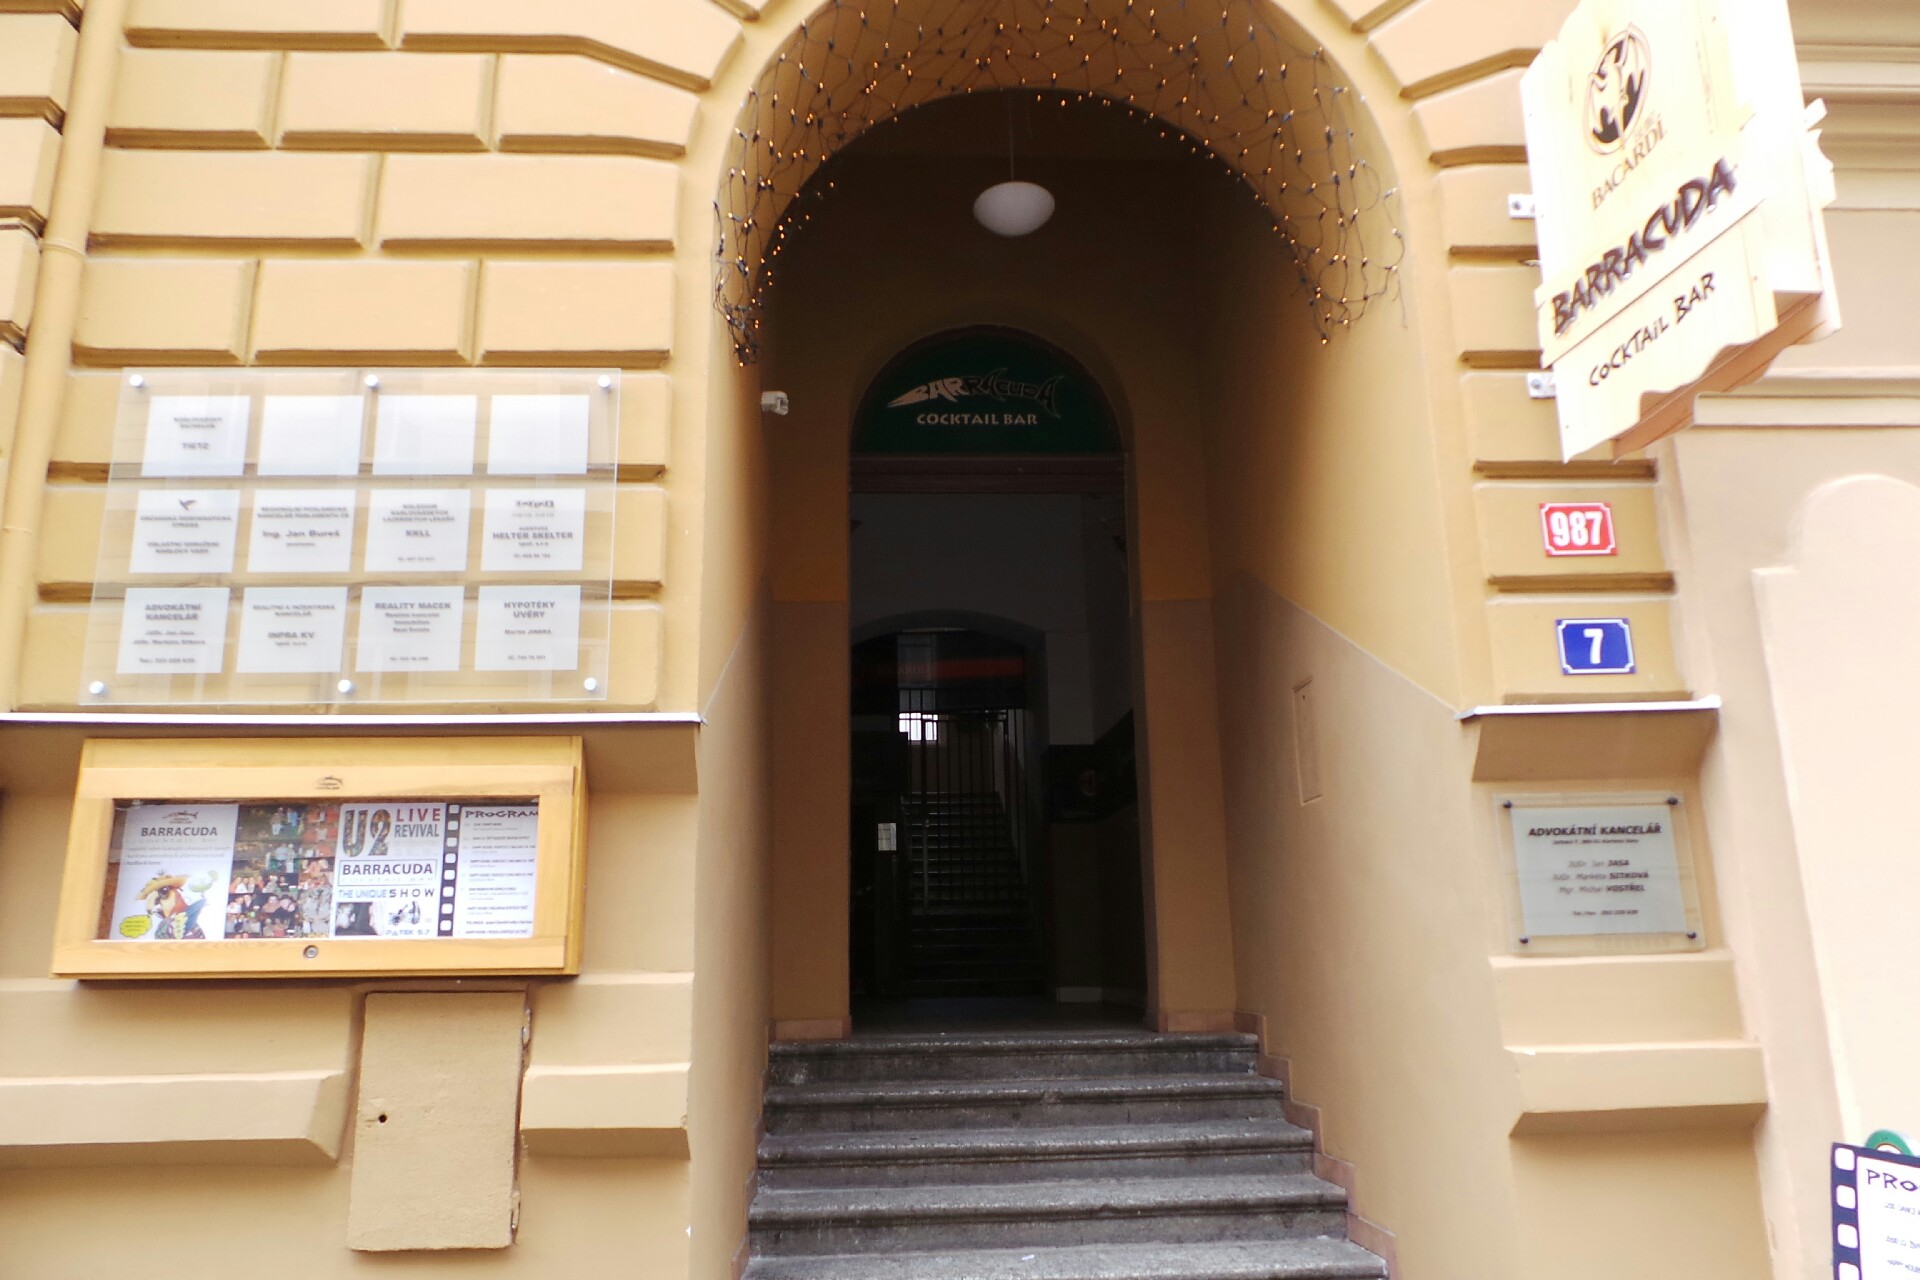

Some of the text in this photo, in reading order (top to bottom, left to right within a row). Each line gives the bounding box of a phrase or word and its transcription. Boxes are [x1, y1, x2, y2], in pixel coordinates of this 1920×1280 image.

[1592, 117, 1665, 210] BACARDI
[1551, 155, 1738, 337] BARRACUDA
[1672, 271, 1717, 324] BAR
[916, 413, 1038, 425] COCKTAIL BAR
[1550, 511, 1603, 546] 987
[1583, 628, 1604, 664] 7
[396, 808, 442, 822] LIVE
[465, 810, 538, 818] PROGRAM
[141, 827, 218, 837] BARRACUDA
[342, 809, 392, 858] U2
[394, 824, 440, 838] REVIVAL
[1529, 822, 1662, 836] ADVOKÁTNÍ KANCELÁŘ
[342, 863, 433, 875] BARRACUDA
[389, 888, 435, 898] SHOW
